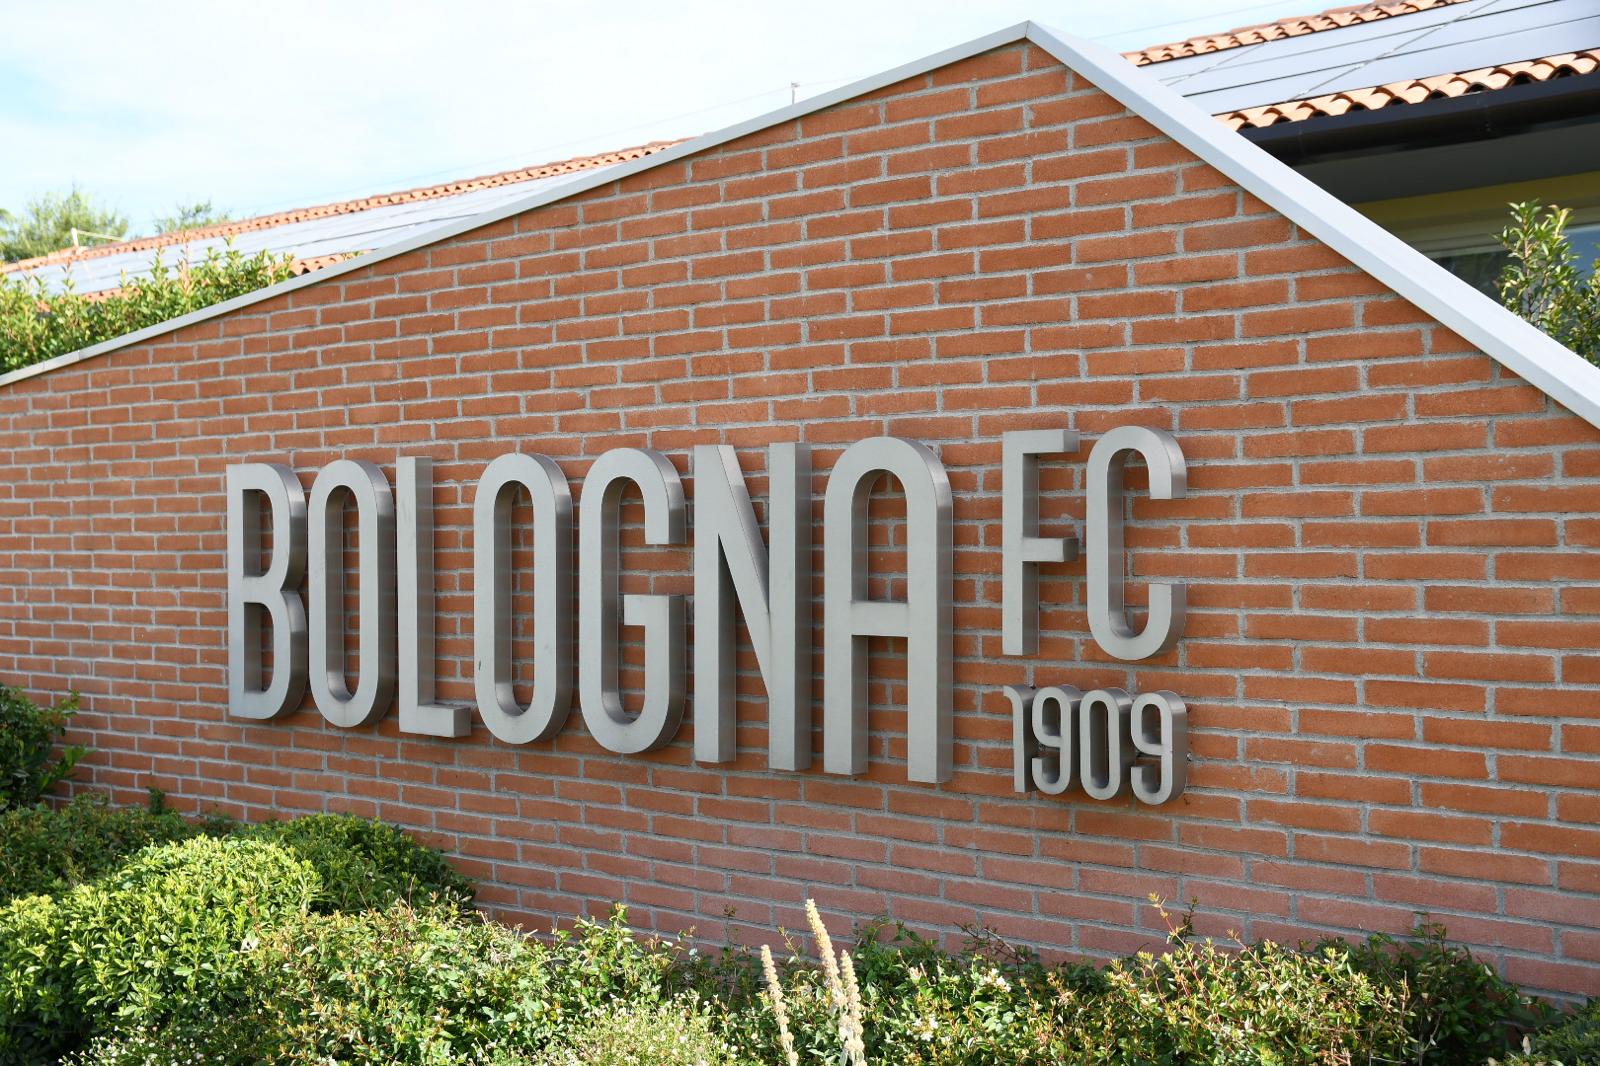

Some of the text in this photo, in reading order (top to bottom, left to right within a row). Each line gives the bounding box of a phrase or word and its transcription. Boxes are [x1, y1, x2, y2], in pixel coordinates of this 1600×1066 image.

[226, 426, 1187, 784] BOLOGNA FC
[1003, 686, 1187, 805] 1909
